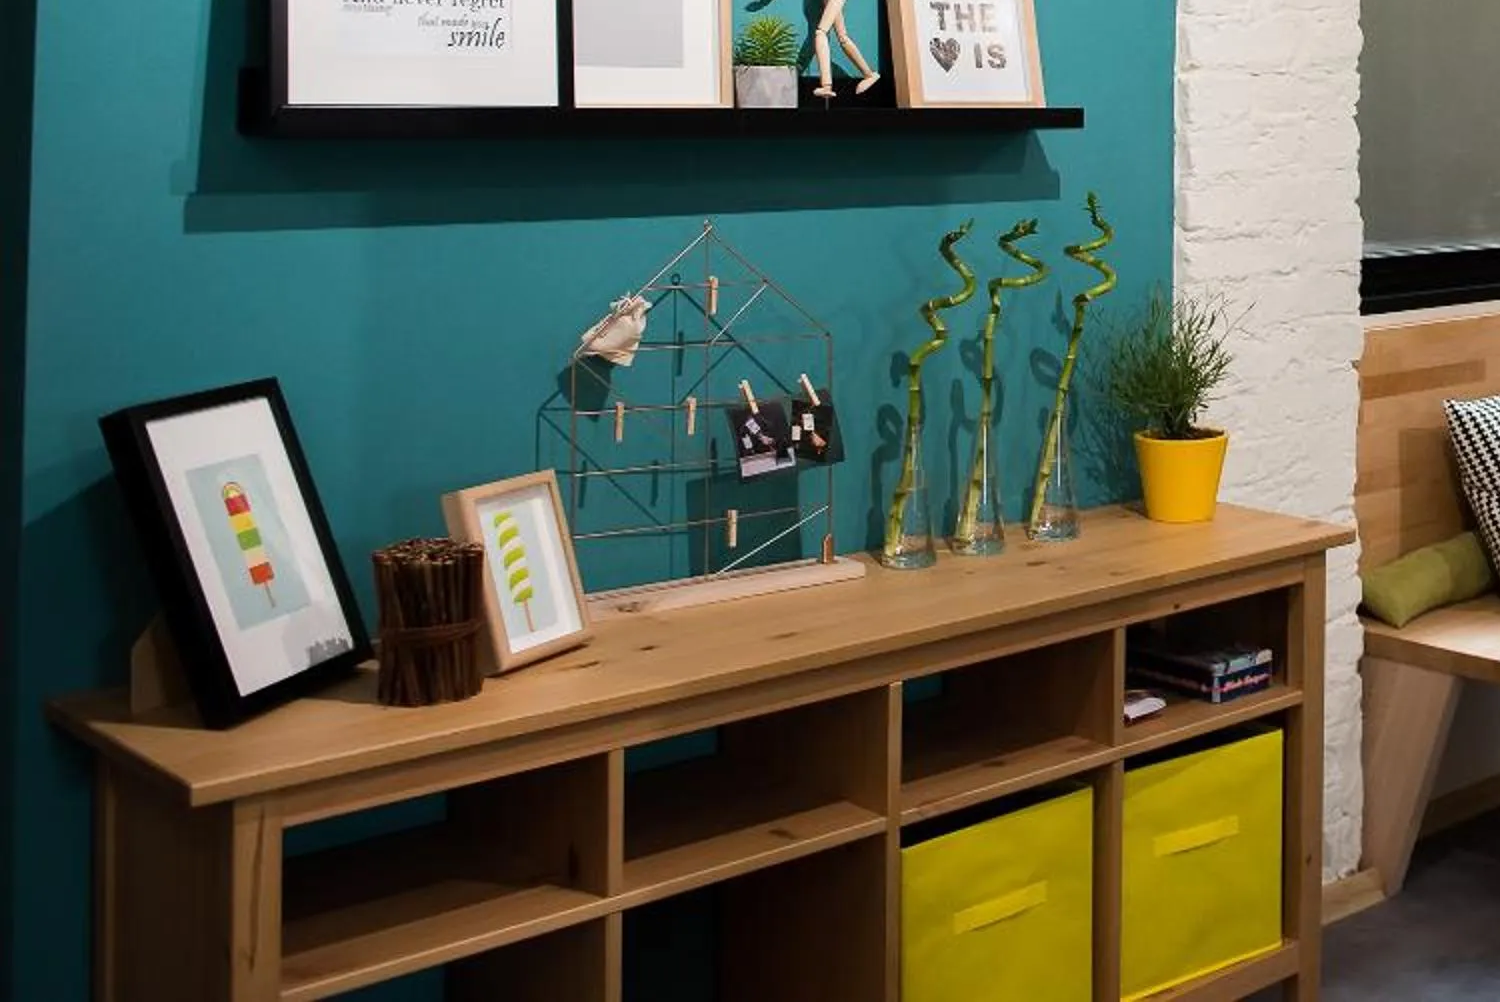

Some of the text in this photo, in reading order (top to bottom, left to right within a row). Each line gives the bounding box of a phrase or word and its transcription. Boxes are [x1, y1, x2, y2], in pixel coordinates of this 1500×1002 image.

[447, 17, 505, 48] smile
[930, 1, 997, 33] THE
[974, 42, 1007, 69] IS
